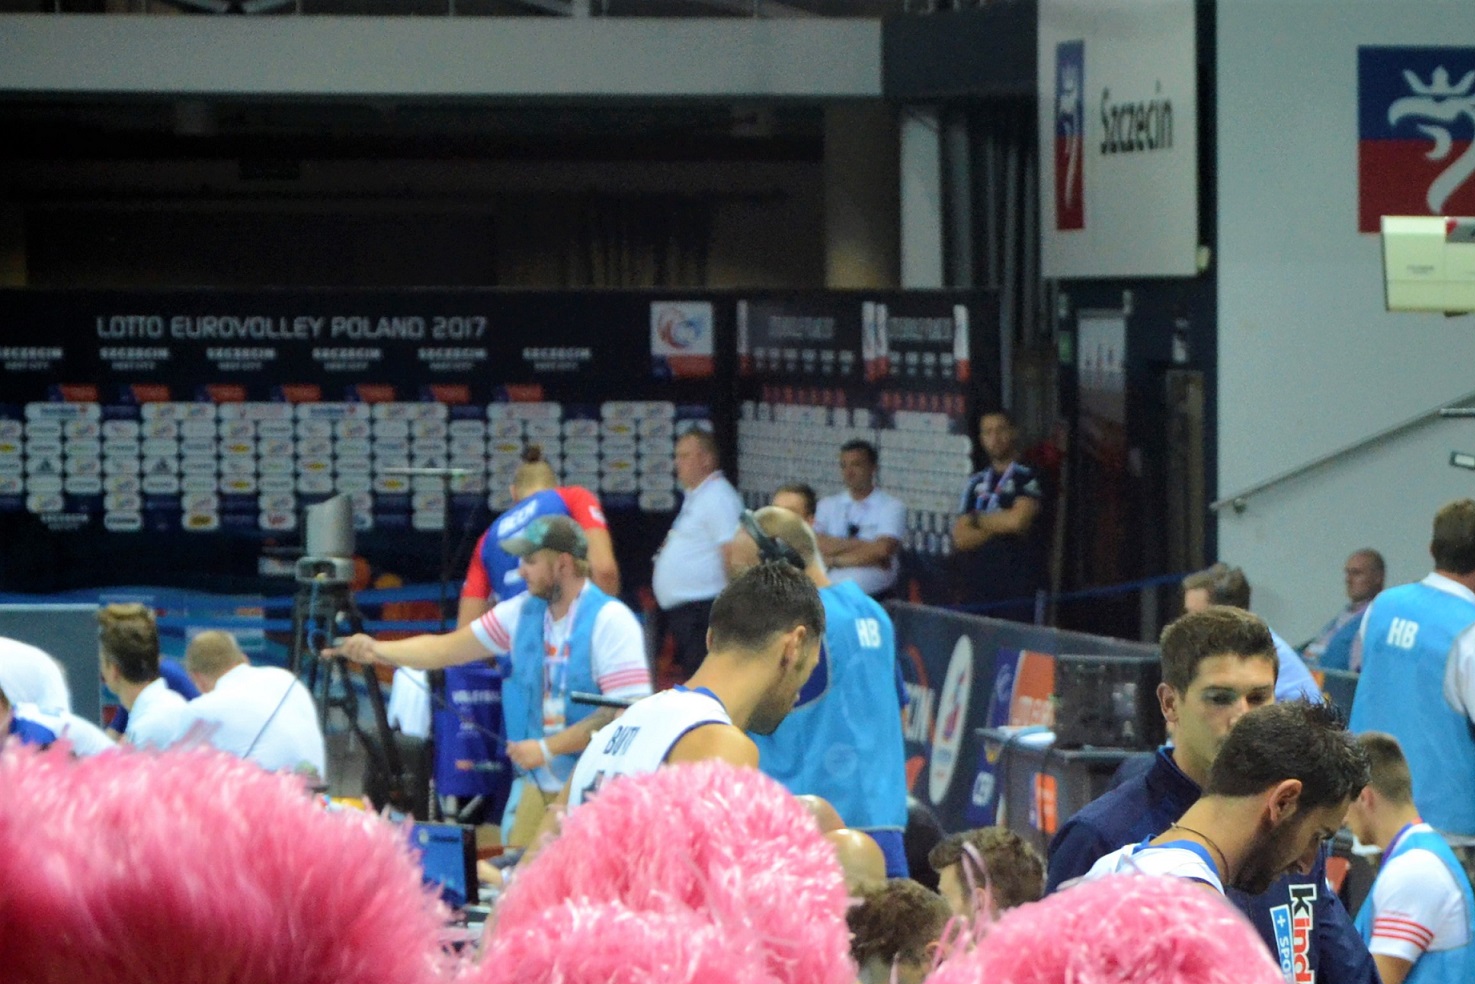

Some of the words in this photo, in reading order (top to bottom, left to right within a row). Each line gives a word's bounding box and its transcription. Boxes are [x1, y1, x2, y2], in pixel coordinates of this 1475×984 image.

[97, 315, 164, 338] LOTTO
[170, 315, 324, 339] EUROVOLLEY
[330, 315, 426, 339] POLAND
[431, 315, 488, 339] 2017
[854, 617, 881, 648] HB
[1387, 616, 1419, 649] HB
